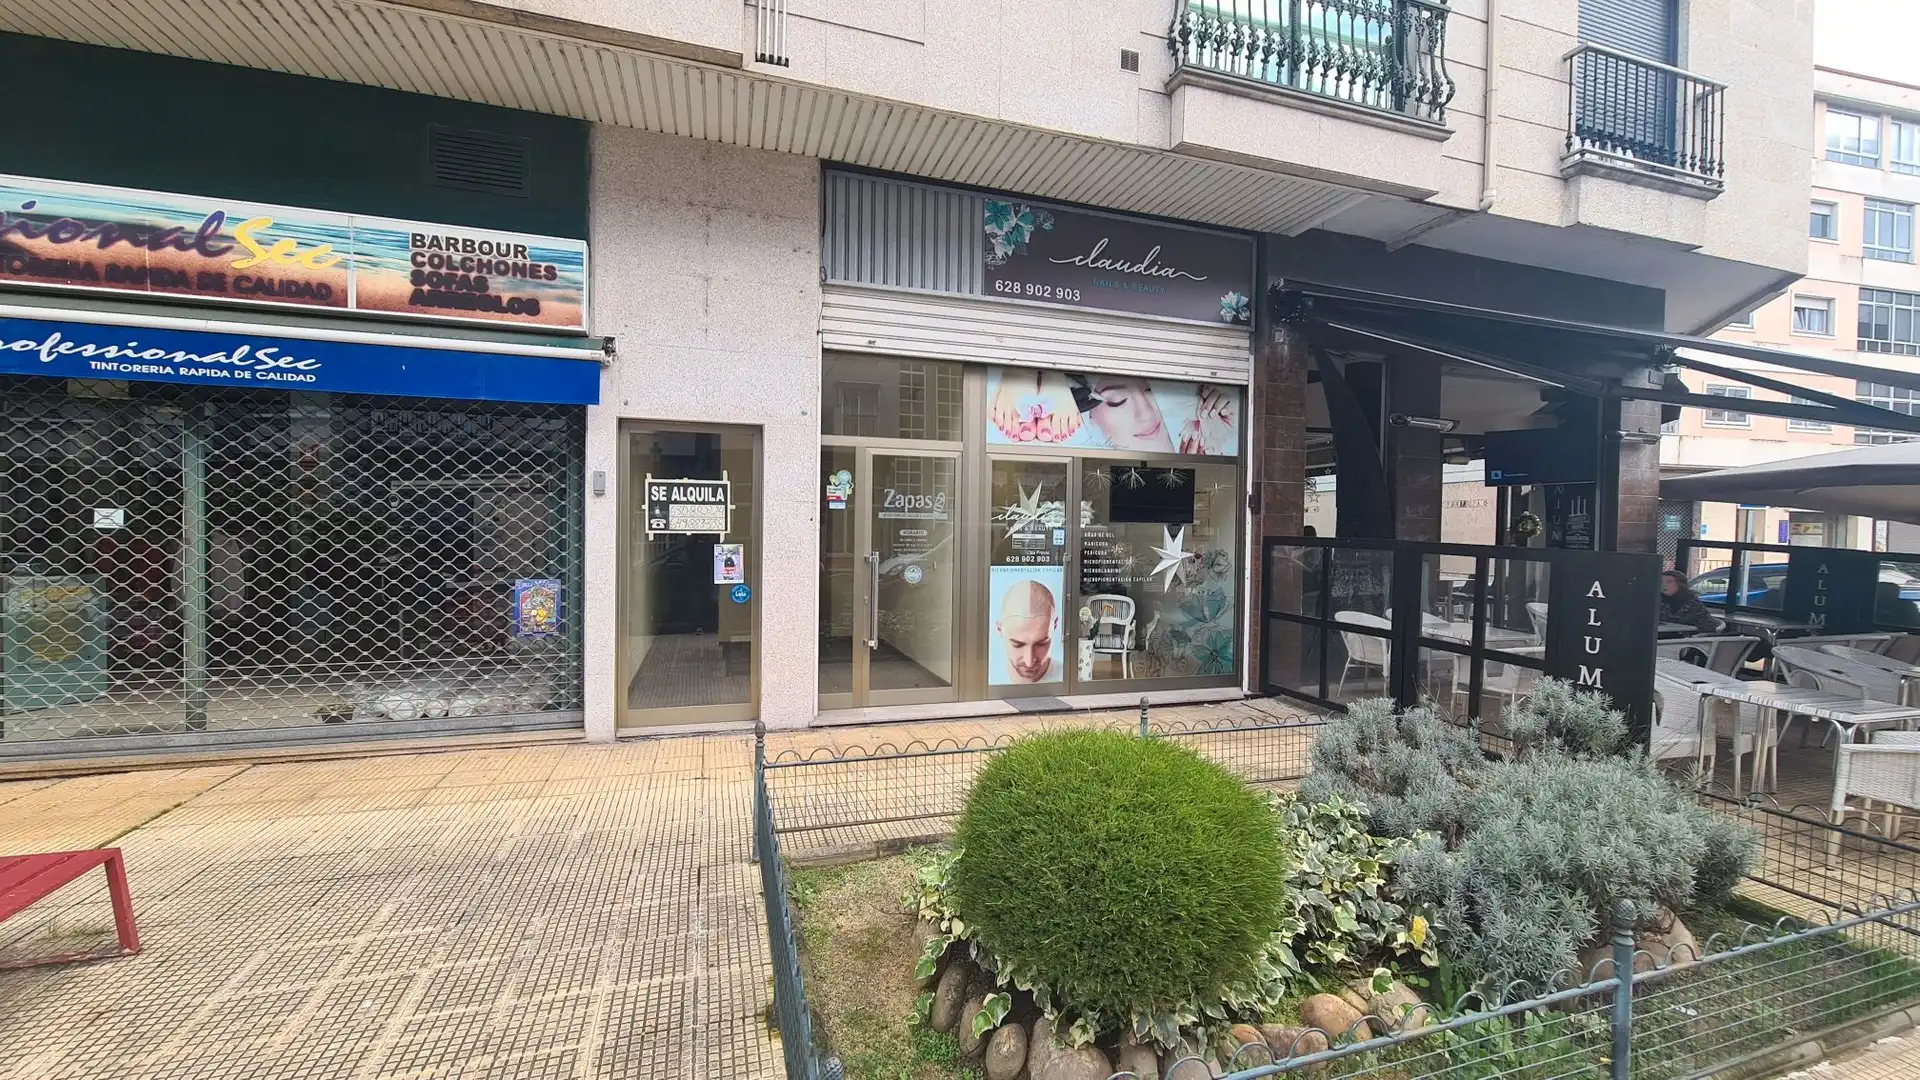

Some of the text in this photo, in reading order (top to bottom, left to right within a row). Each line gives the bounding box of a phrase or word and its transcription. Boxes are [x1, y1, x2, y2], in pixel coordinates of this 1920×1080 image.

[411, 232, 529, 260] BARBOUR
[410, 251, 558, 281] COLCHONES
[233, 275, 333, 300] CALIDAD
[995, 279, 1081, 302] 628 902 903
[89, 360, 317, 383] TINTORERIA RAPIDA DE CALIDAD
[650, 485, 725, 503] SE ALQUILA
[884, 488, 933, 513] Zapas
[1006, 555, 1050, 563] 628 902 903
